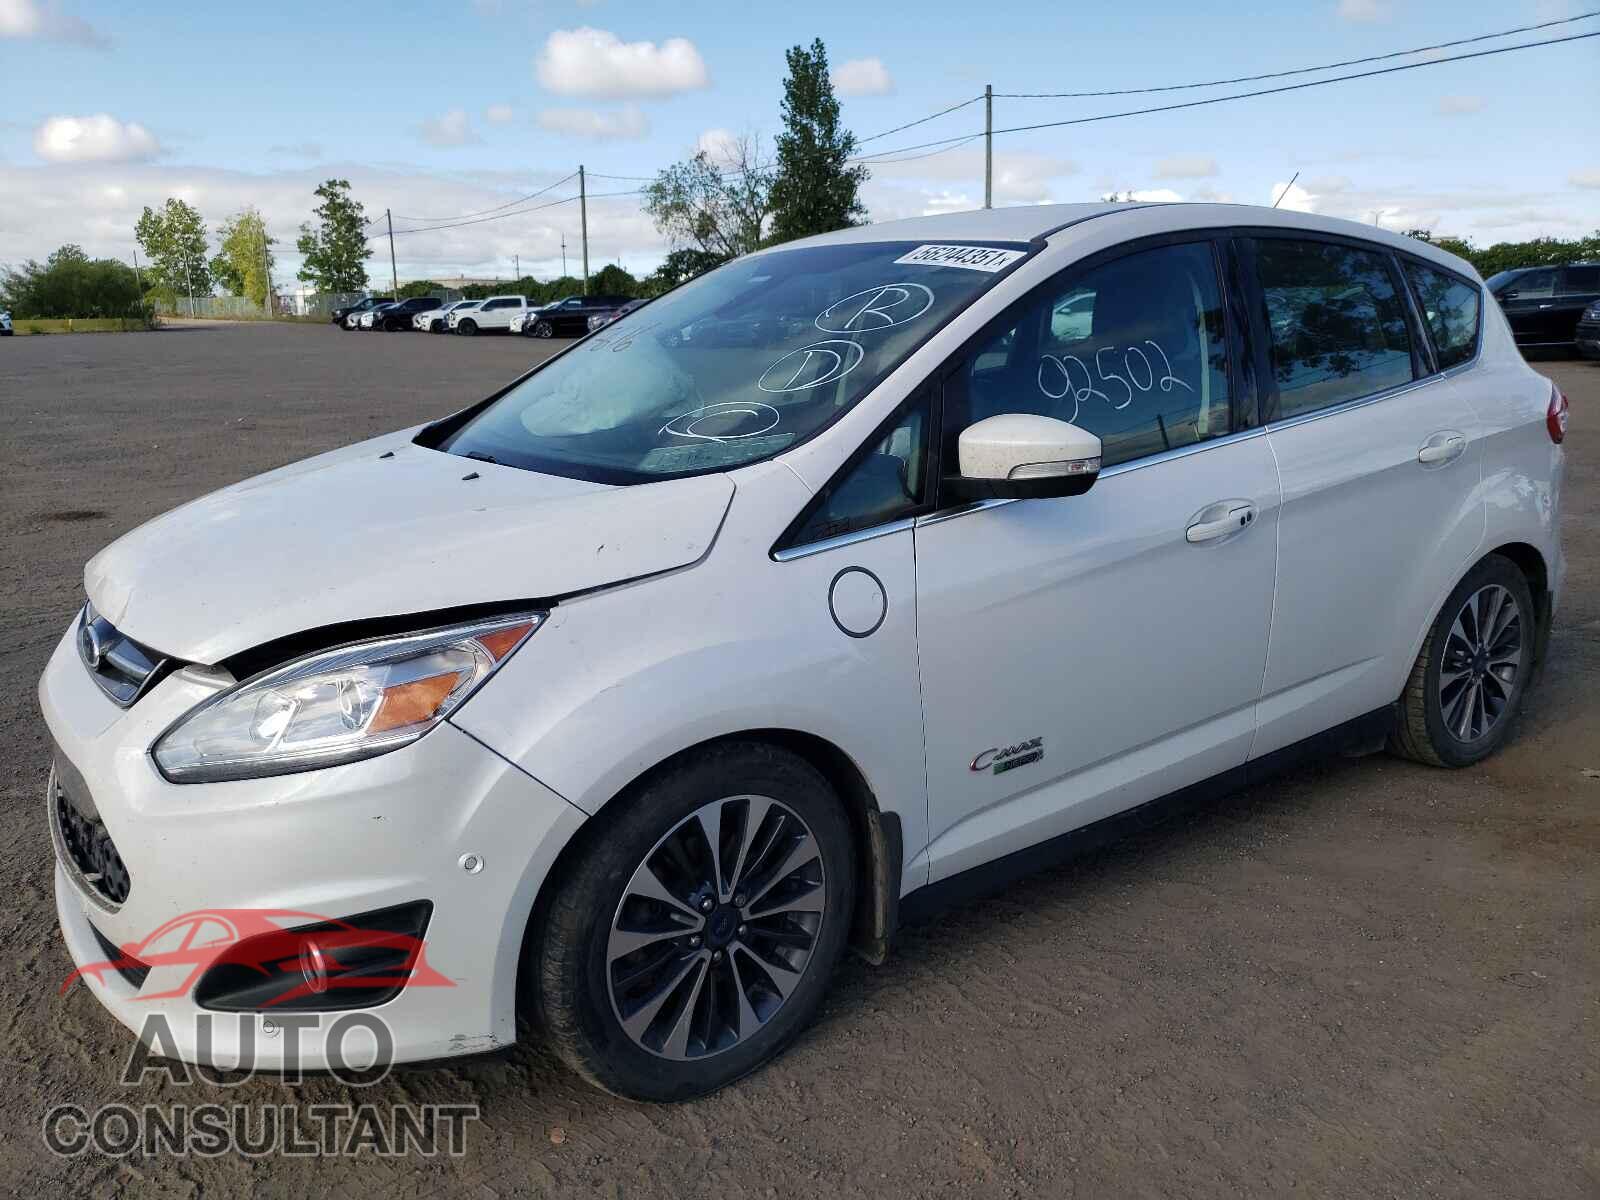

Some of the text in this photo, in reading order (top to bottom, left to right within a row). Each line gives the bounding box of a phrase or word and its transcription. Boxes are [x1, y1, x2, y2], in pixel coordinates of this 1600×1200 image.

[844, 286, 910, 329] R
[783, 349, 841, 389] D
[1038, 340, 1195, 424] 92502
